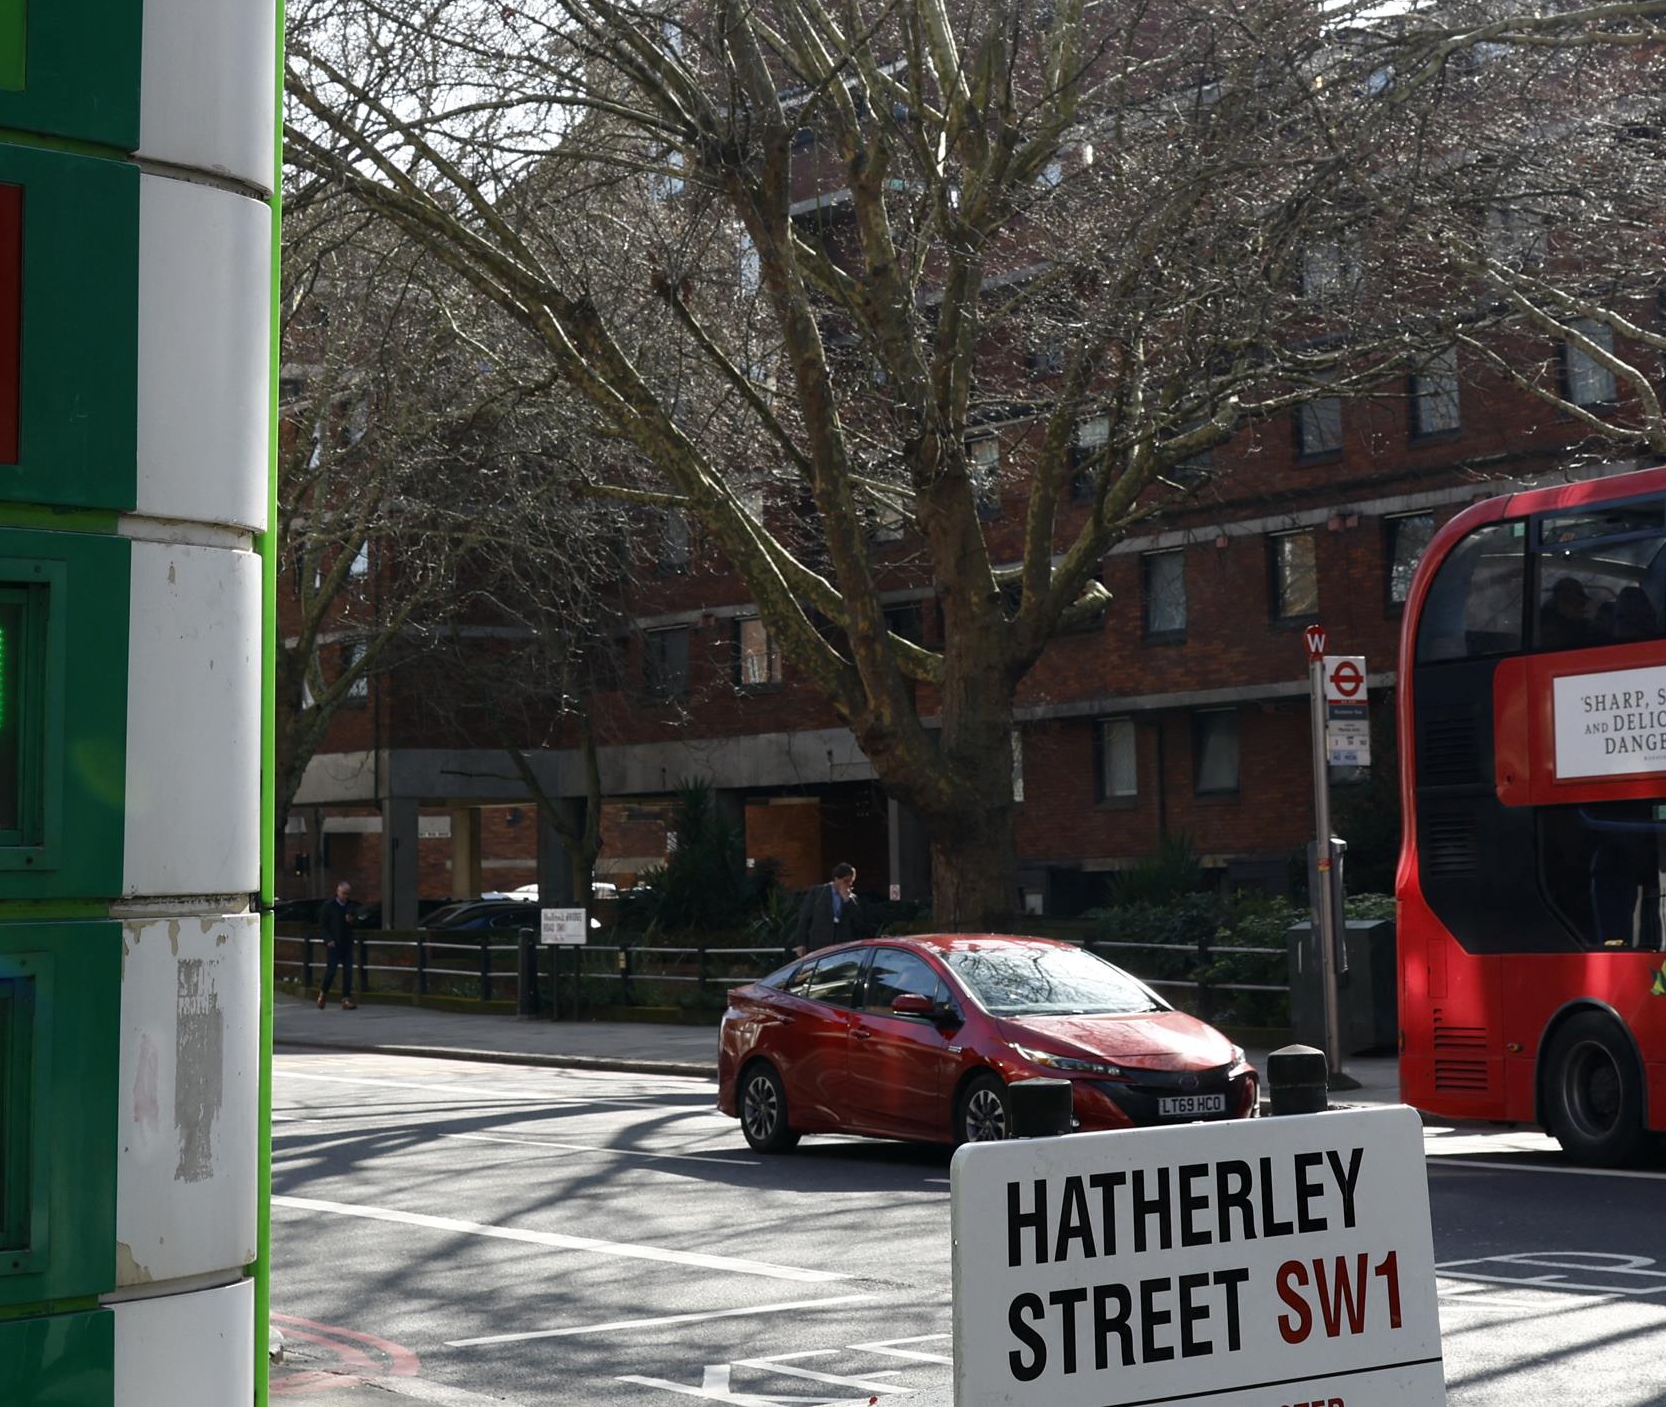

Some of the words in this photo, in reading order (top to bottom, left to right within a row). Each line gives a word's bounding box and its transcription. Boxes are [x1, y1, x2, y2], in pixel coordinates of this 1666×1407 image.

[1307, 633, 1325, 653] W
[1585, 722, 1608, 734] AND
[1163, 1097, 1194, 1113] LT69
[1197, 1096, 1221, 1111] HCO
[1007, 1147, 1364, 1268] HATHERLEY
[1008, 1267, 1250, 1383] STREET
[1275, 1250, 1403, 1346] SW1
